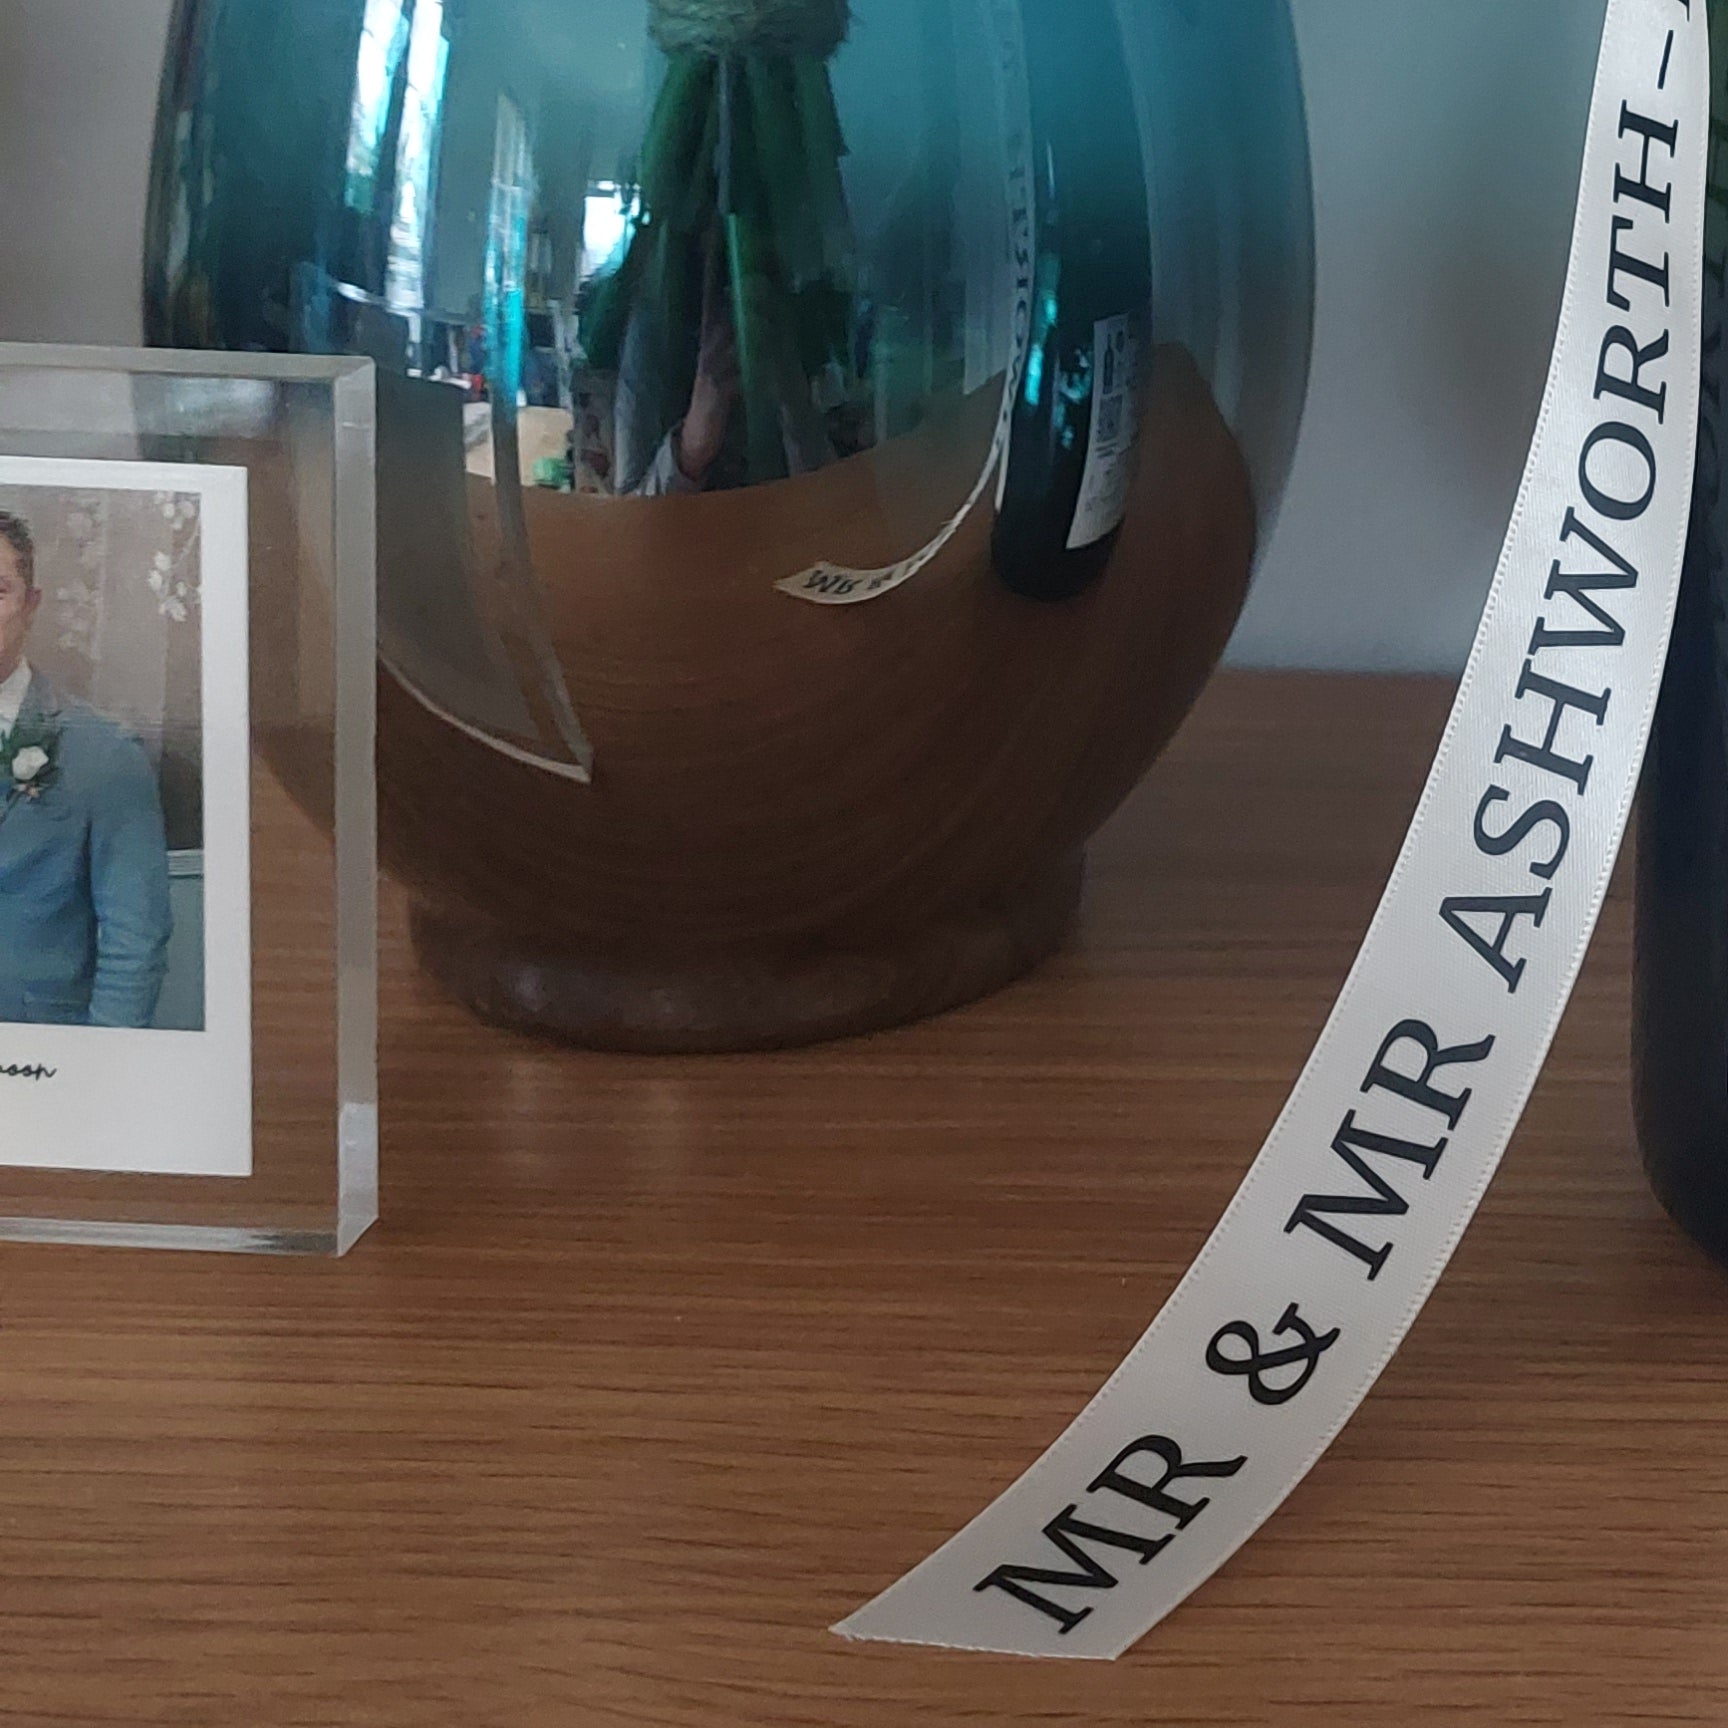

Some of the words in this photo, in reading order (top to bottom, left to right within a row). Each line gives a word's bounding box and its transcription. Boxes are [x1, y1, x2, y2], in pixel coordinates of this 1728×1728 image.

[971, 1434, 1248, 1635] MR
[1204, 1301, 1342, 1406] &
[1282, 1016, 1497, 1282] MR
